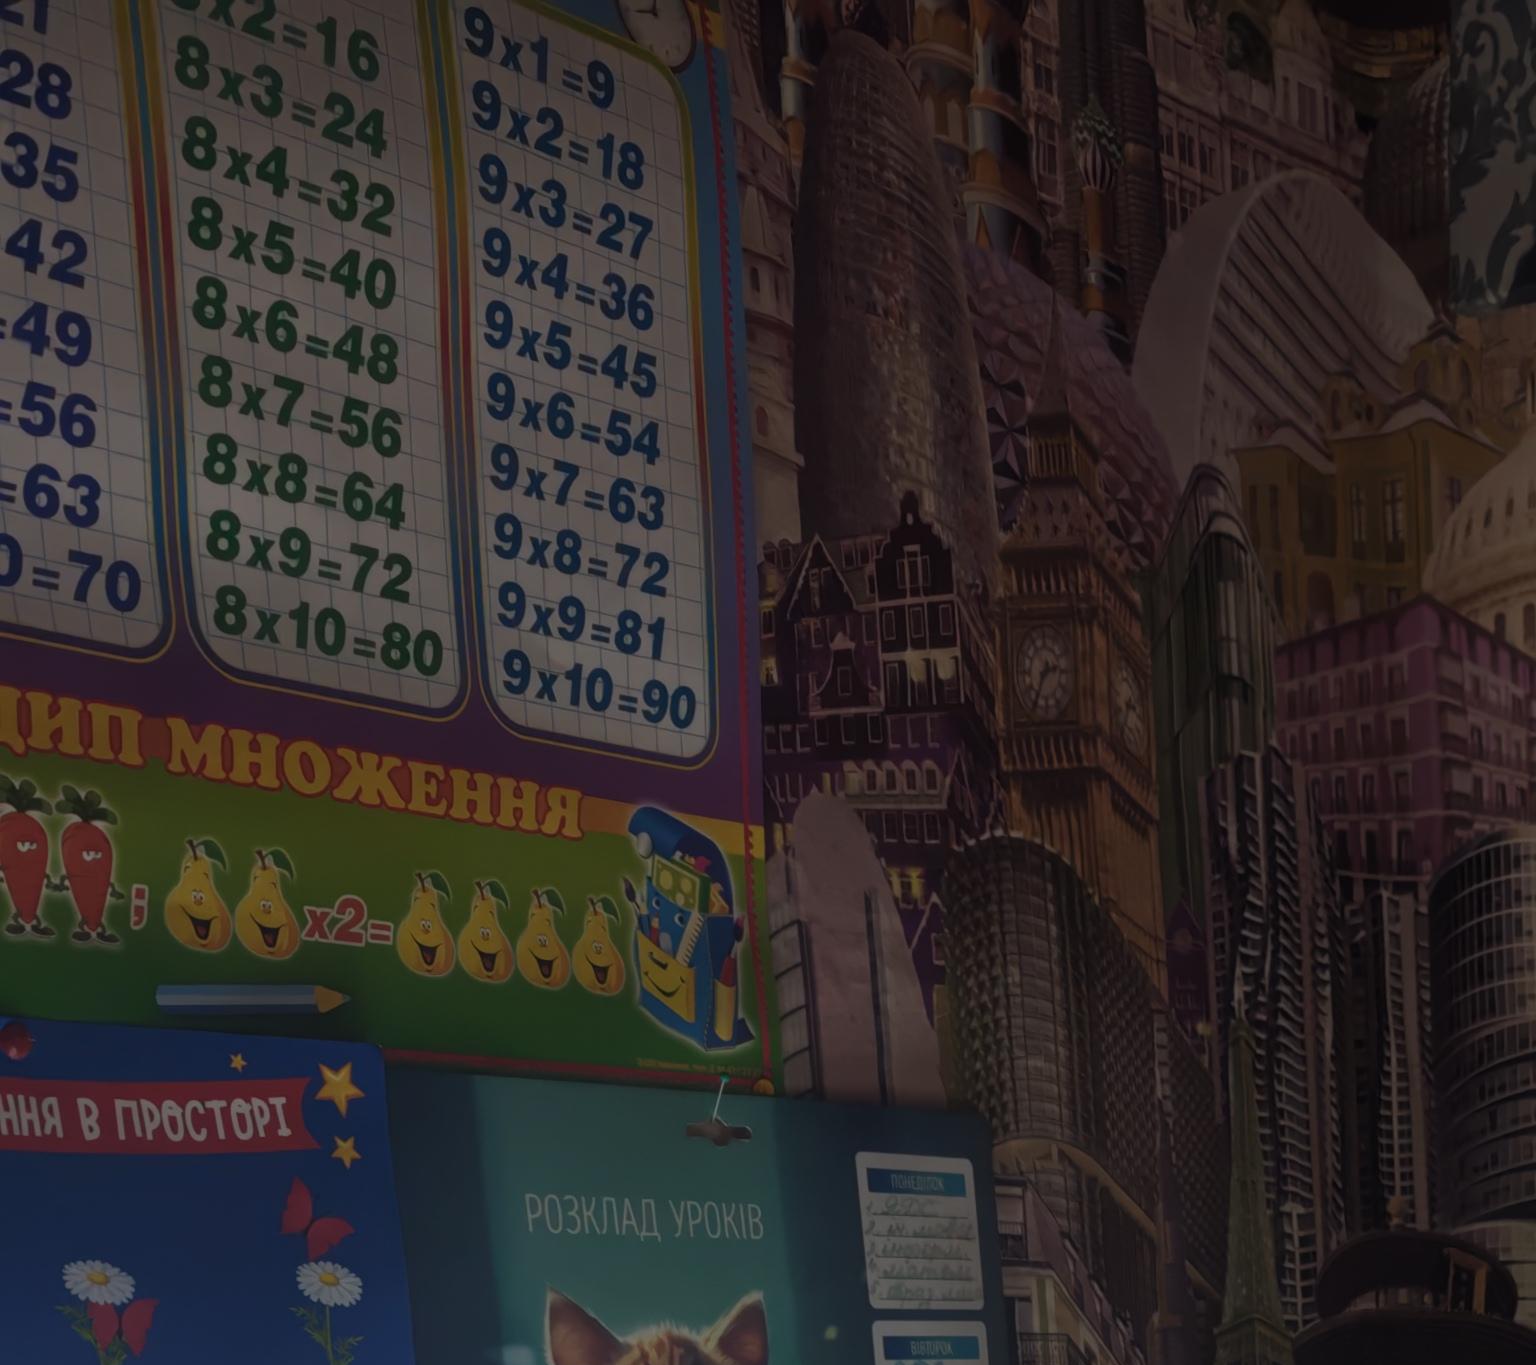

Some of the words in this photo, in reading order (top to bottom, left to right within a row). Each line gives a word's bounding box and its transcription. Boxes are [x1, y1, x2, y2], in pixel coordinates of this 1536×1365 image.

[0, 49, 72, 119] 28
[172, 0, 379, 81] x2=16
[464, 7, 614, 109] 9x1=9
[175, 36, 386, 158] 8x3=24
[472, 80, 644, 190] 9x2=18
[0, 132, 79, 202] 35
[182, 116, 394, 237] 8x4=32
[479, 154, 653, 260] 9x3=27
[5, 219, 87, 288] 42
[188, 197, 396, 309] 8x5=40
[482, 228, 654, 330] 9x4=36
[0, 302, 91, 366] 49
[192, 276, 398, 384] 8x6=48
[484, 301, 656, 397] 9x5=45
[199, 355, 402, 457] 8x7=56
[487, 373, 660, 465] 9x6=54
[203, 433, 405, 530] 8x8=64
[490, 443, 664, 530] 9x7=63
[207, 510, 412, 603] 8x9=72
[494, 513, 669, 597] 9x8=72
[214, 586, 443, 676] 8x10=80
[498, 582, 664, 661] 9x9=81
[503, 649, 696, 729] 9x10=90
[167, 716, 584, 839] МНОЖЕННЯ
[76, 1096, 101, 1141] В
[114, 1096, 292, 1142] ПРОСТОРІ
[524, 1193, 662, 1242] РОЗКЛАД
[668, 1197, 765, 1241] УРОКІВ
